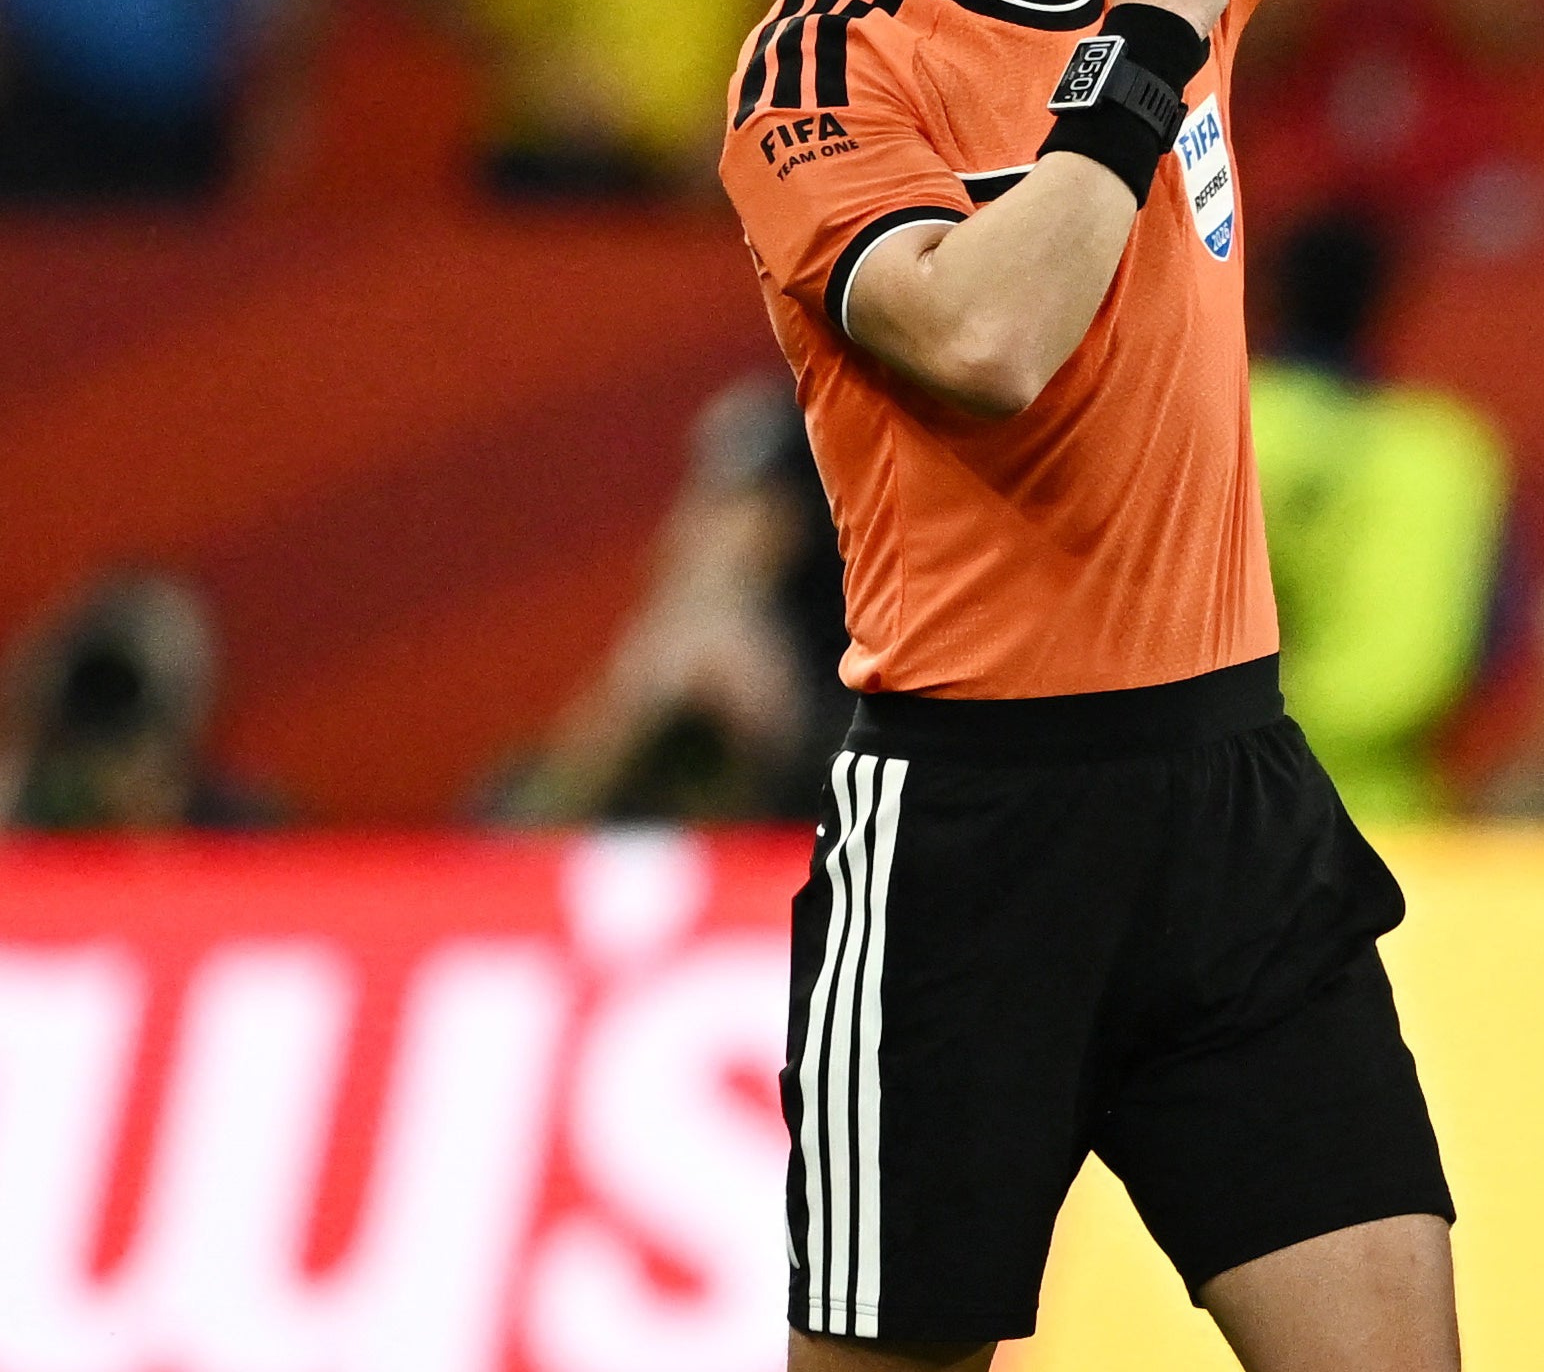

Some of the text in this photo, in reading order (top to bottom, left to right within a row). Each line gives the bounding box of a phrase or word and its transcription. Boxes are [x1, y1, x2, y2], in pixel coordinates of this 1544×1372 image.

[760, 112, 848, 165] FIFA
[776, 139, 860, 182] TEAM ONE
[1178, 112, 1220, 171] FIFA
[1194, 165, 1229, 214] REFEREE
